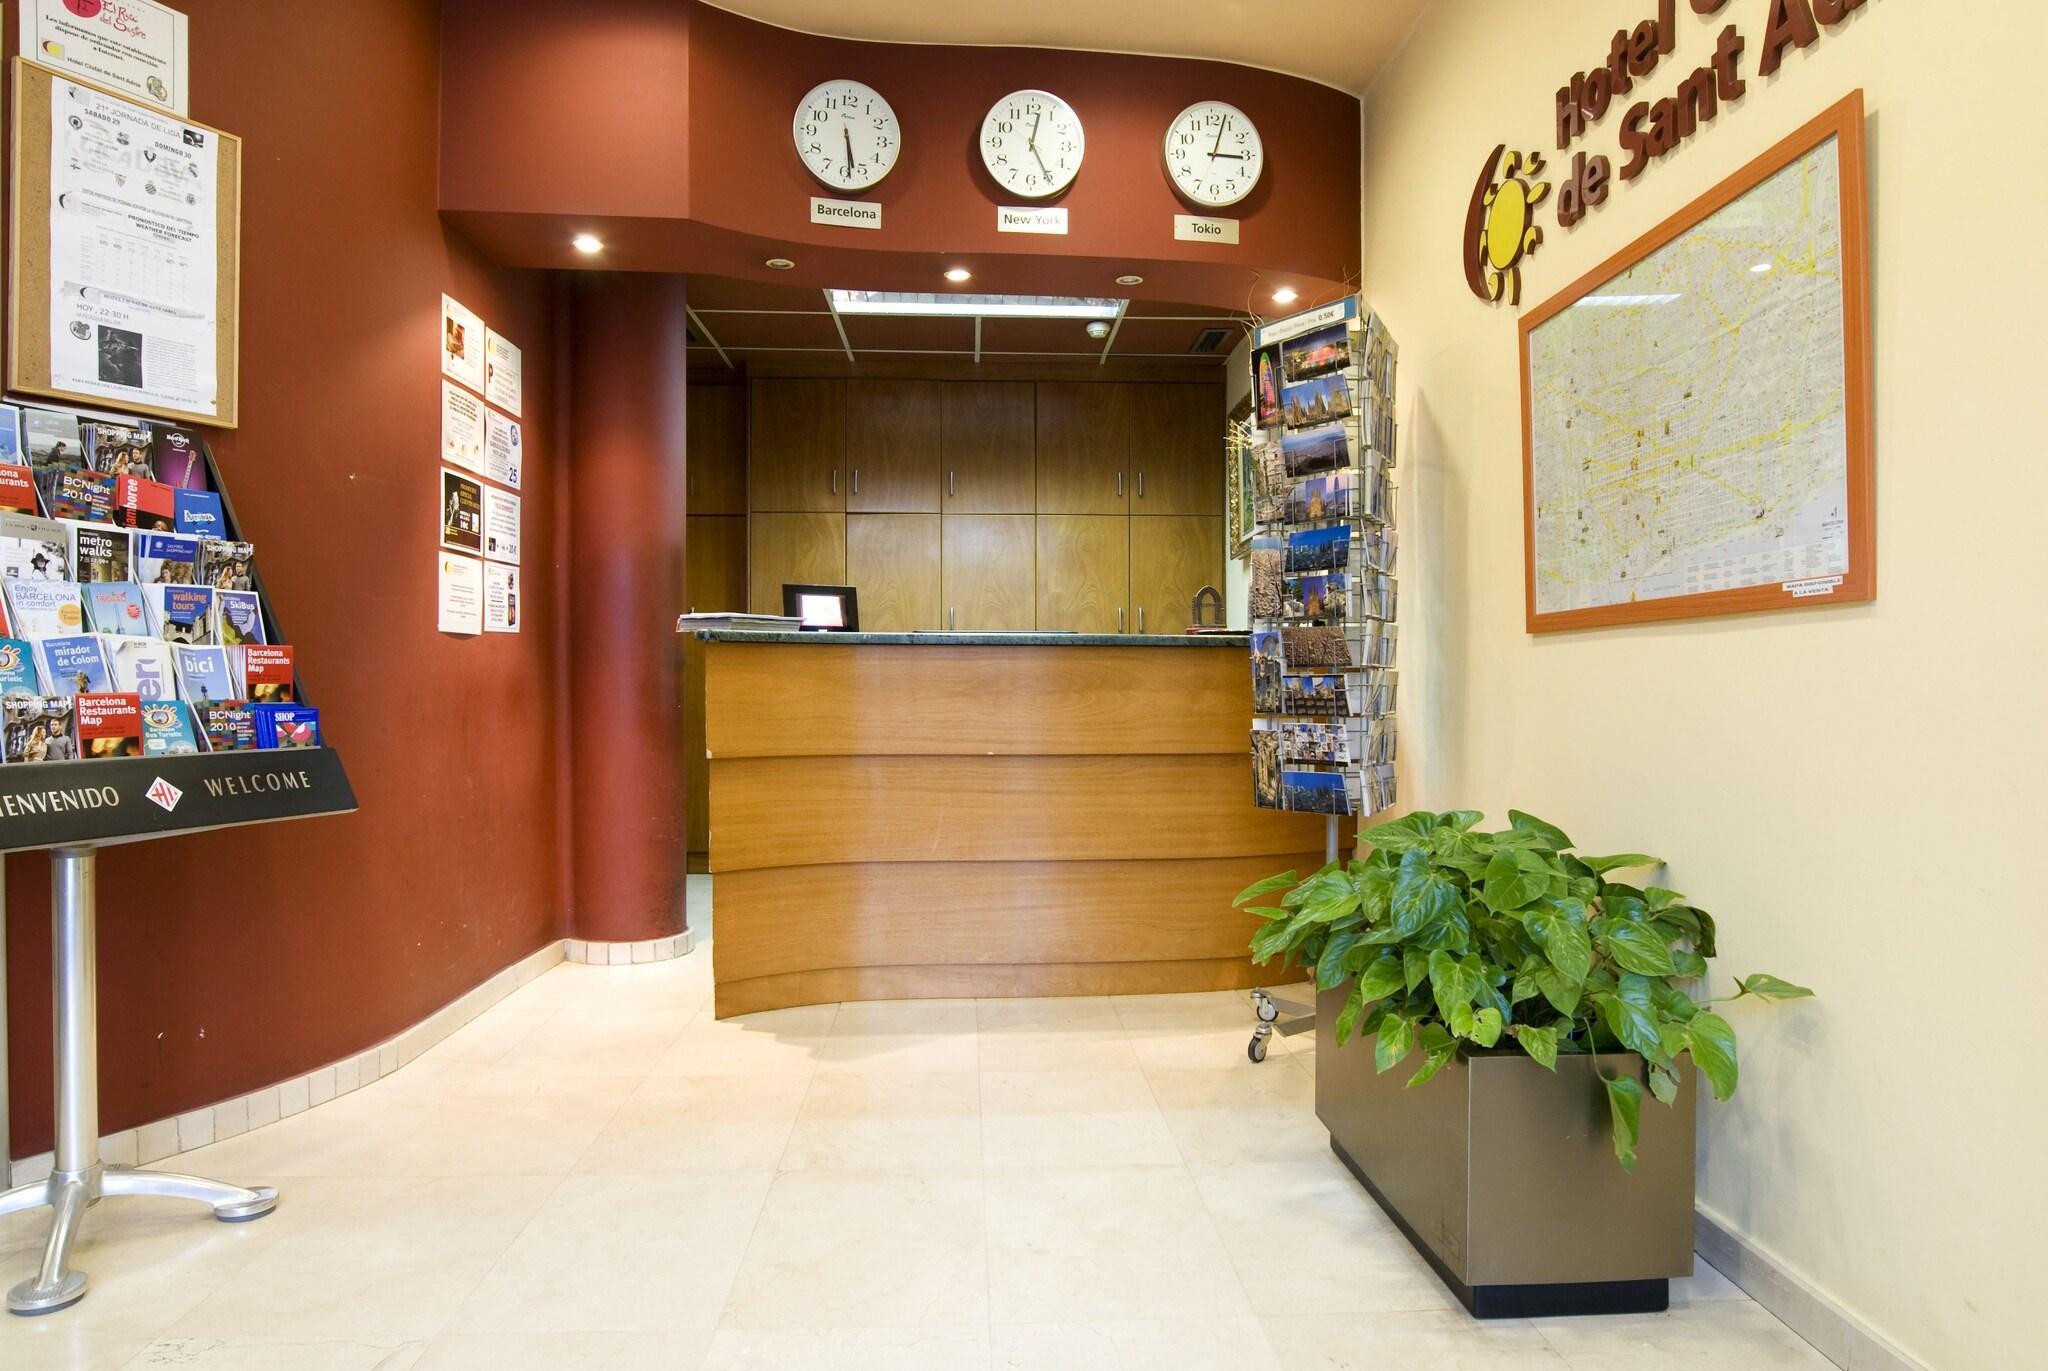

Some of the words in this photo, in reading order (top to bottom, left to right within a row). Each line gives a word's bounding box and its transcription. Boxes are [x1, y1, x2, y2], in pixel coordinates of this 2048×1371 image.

[1556, 0, 1676, 149] Hotel
[826, 98, 837, 110] 11
[842, 95, 858, 108] 12
[865, 104, 871, 115] 1
[1009, 108, 1021, 120] 11
[1026, 104, 1042, 115] 12
[1049, 110, 1054, 121] 1
[112, 117, 121, 126] 29
[813, 110, 828, 123] 10
[1205, 114, 1220, 127] 12
[110, 108, 151, 128] JORNADA
[150, 122, 162, 132] DE
[163, 127, 182, 139] LIGA
[873, 118, 884, 130] 2
[998, 121, 1013, 133] 10
[1191, 120, 1201, 132] 11
[1227, 120, 1232, 131] 1
[1557, 151, 1610, 227] de
[1619, 24, 1746, 181] Sant
[806, 124, 817, 136] 9
[1057, 124, 1067, 136] 2
[877, 136, 888, 149] 3
[991, 136, 1003, 149] 9
[1180, 134, 1194, 145] 10
[1235, 133, 1245, 144] 2
[154, 141, 184, 157] DOMINGO
[810, 143, 822, 154] 8
[1061, 141, 1072, 153] 3
[870, 152, 879, 164] 4
[996, 154, 1007, 166] 8
[1175, 149, 1186, 160] 9
[1241, 150, 1251, 161] 3
[823, 158, 833, 170] 7
[1056, 157, 1064, 169] 4
[839, 166, 850, 178] 6
[857, 163, 868, 176] 5
[1009, 168, 1018, 180] 7
[1181, 165, 1192, 177] 8
[1236, 166, 1245, 178] 4
[1025, 174, 1036, 186] 6
[1193, 179, 1203, 191] 7
[1226, 179, 1235, 191] 5
[1209, 184, 1220, 195] 6
[817, 204, 877, 219] Barcelona
[1004, 214, 1031, 225] New
[1035, 214, 1061, 225] York
[136, 222, 163, 234] WEATHER
[163, 230, 192, 243] FORECAST
[1191, 223, 1222, 235] Tokio
[97, 427, 133, 439] SHOPPING
[63, 475, 111, 494] BCNight
[62, 487, 93, 502] 2010
[79, 535, 113, 548] metro
[79, 546, 113, 557] walks
[15, 584, 38, 593] Enjoy
[15, 592, 77, 601] BARCELONA
[172, 592, 208, 604] walking
[172, 601, 197, 611] tours
[230, 600, 256, 611] SkiBus
[54, 646, 91, 656] mirador
[247, 649, 283, 657] Barcelona
[57, 658, 69, 666] de
[70, 655, 99, 665] Colom
[185, 656, 215, 674] bici
[247, 657, 290, 665] Restaurants
[247, 665, 265, 674] Map
[5, 701, 48, 710] SHOPPING
[78, 697, 127, 707] Barcelona
[79, 706, 137, 716] Restaurants
[209, 710, 252, 721] BCNight
[274, 712, 295, 722] SHOP
[80, 717, 103, 726] Map
[209, 722, 237, 731] 2010
[204, 770, 313, 798] WELCOME
